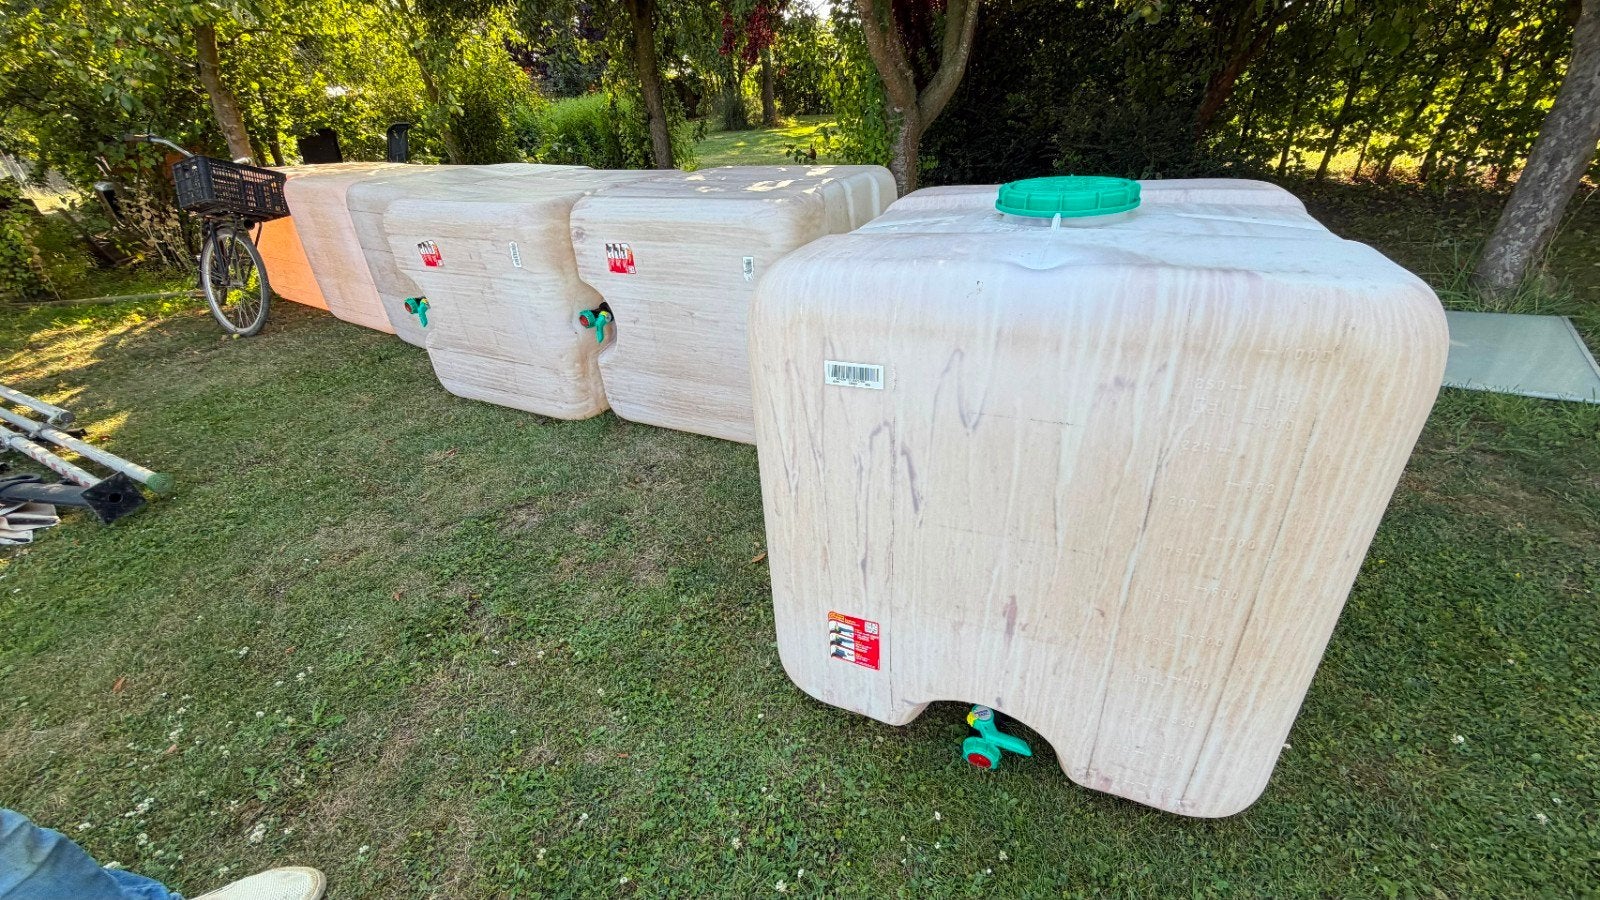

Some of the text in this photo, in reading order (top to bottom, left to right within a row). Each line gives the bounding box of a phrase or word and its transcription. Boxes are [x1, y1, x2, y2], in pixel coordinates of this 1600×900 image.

[1194, 377, 1226, 391] 250
[1180, 440, 1210, 454] 225
[1169, 496, 1196, 509] 200
